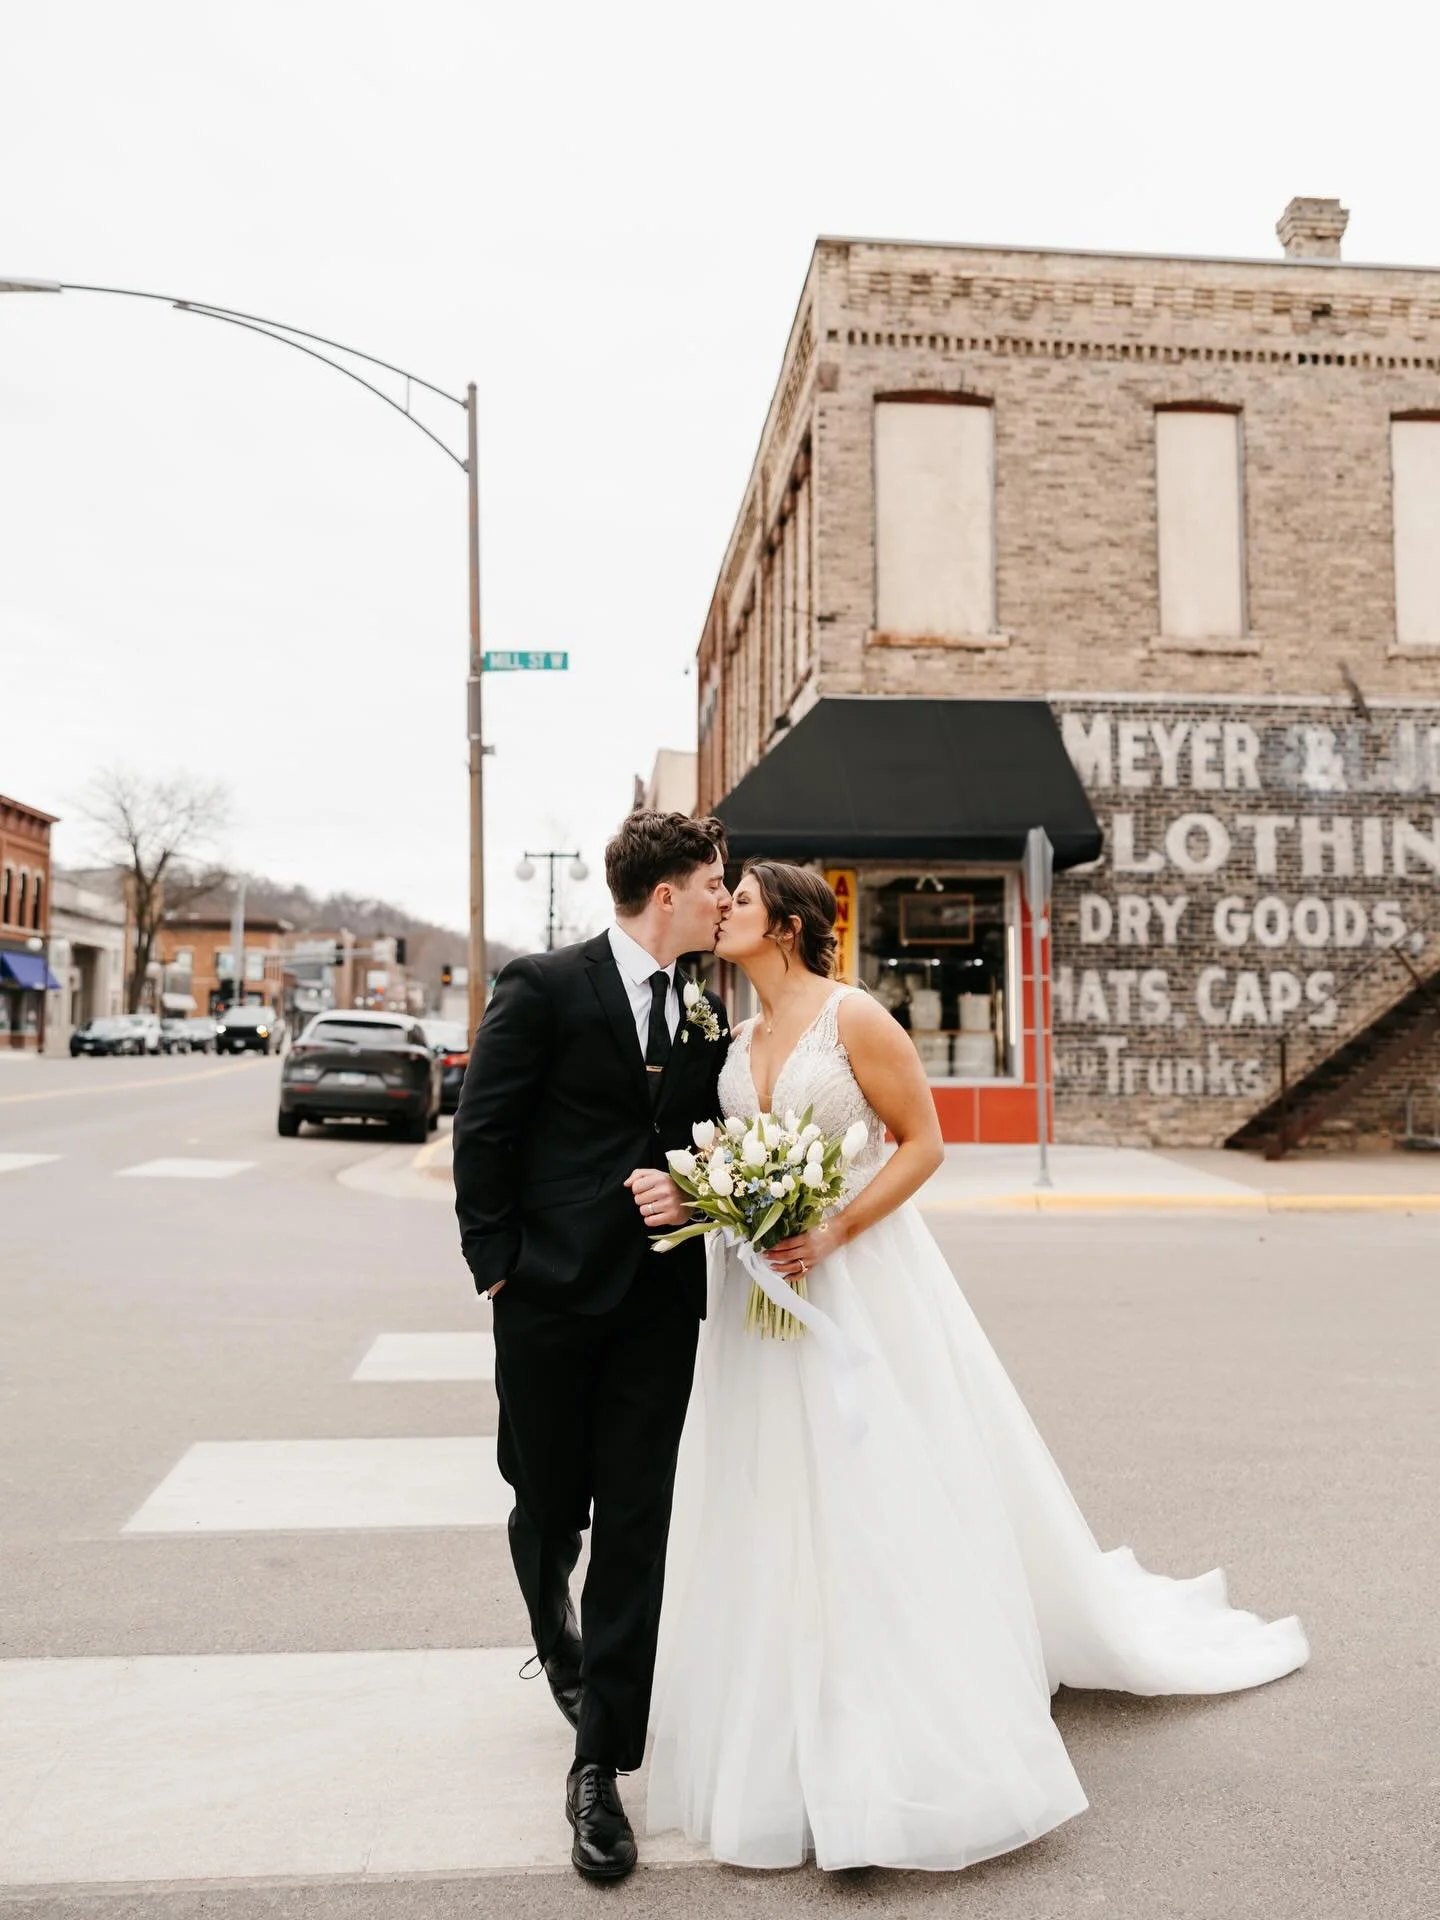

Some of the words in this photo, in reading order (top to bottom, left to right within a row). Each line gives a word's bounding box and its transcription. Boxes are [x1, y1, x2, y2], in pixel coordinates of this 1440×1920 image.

[1061, 713, 1262, 788] MEYER
[1066, 813, 1440, 876] LOTHIN
[1080, 894, 1188, 945] DRY
[1197, 966, 1338, 1026] CAPS
[1097, 1035, 1266, 1096] Trunks
